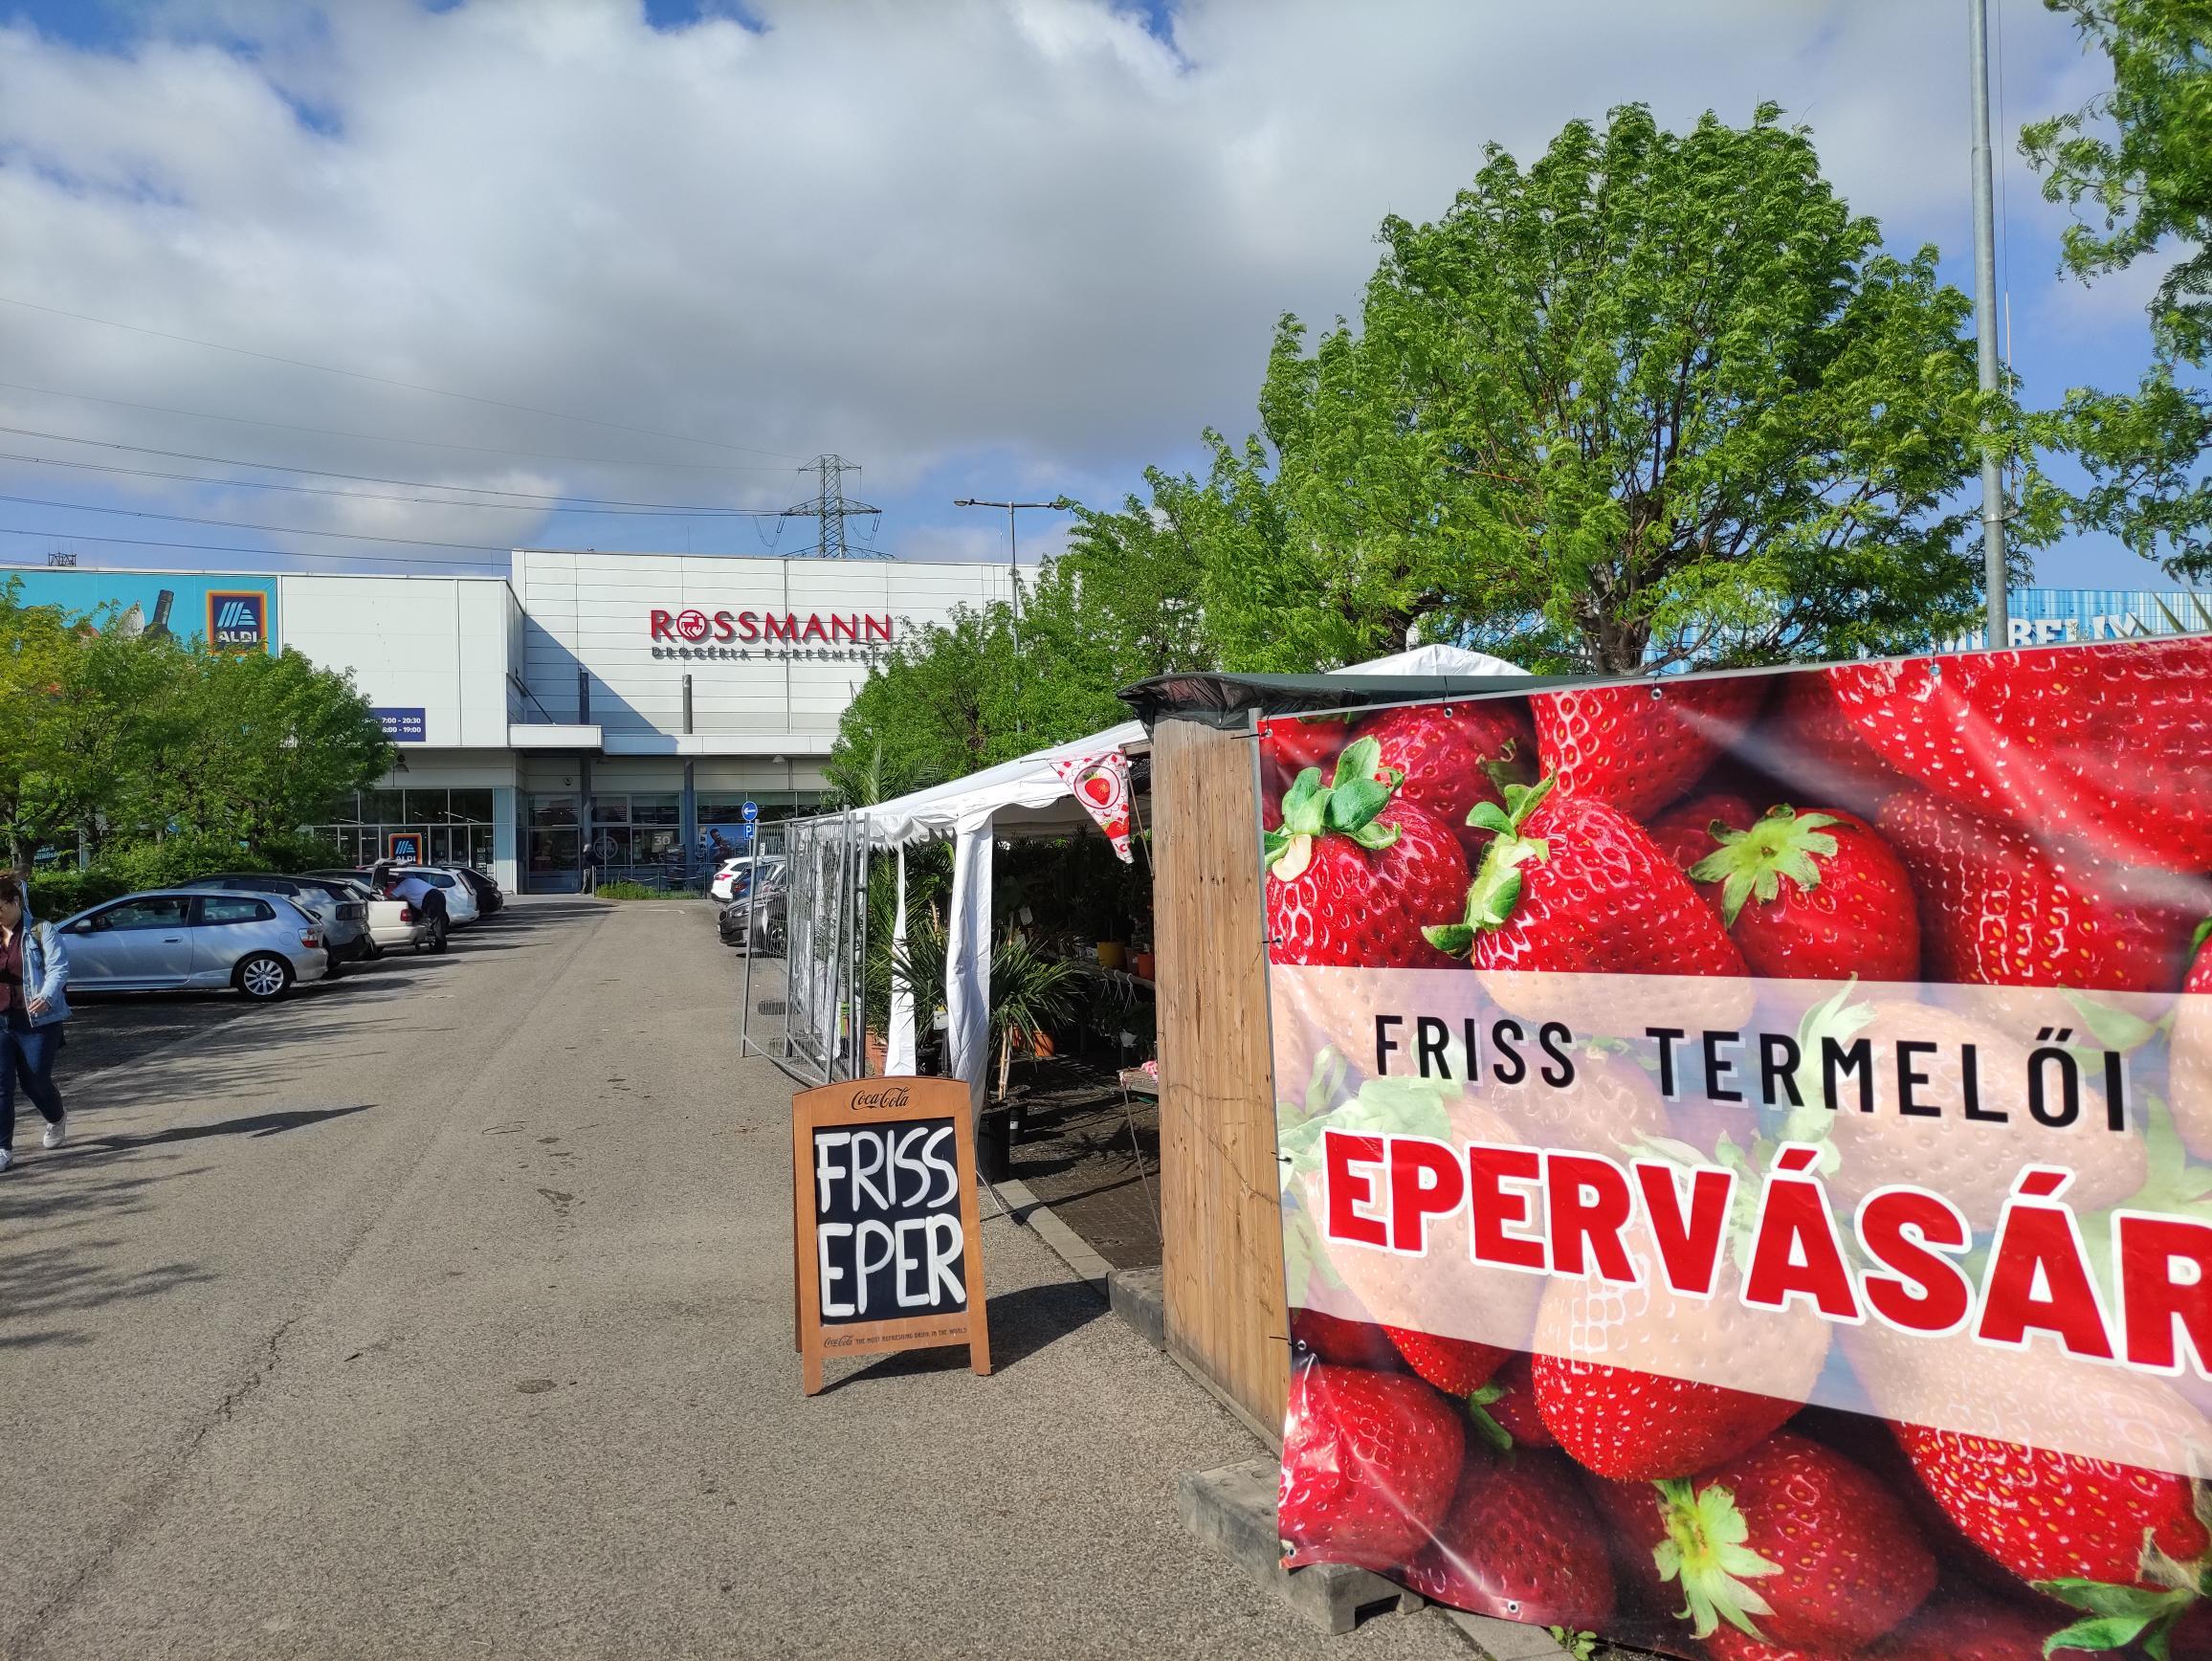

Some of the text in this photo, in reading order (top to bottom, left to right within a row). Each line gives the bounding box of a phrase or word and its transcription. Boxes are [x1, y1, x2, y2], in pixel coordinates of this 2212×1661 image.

[217, 631, 257, 643] ALDI
[652, 609, 893, 642] ROSSMANN
[652, 645, 748, 659] DROGÉRIA
[746, 825, 752, 837] P
[1374, 1014, 2126, 1132] FRISS TERMELŐI
[851, 1086, 910, 1111] Coca-Cola
[815, 1126, 959, 1214] FRISS
[817, 1213, 967, 1318] EPER
[1320, 1129, 2212, 1376] EPERVÁSÁR
[824, 1335, 853, 1348] Coca-Cola
